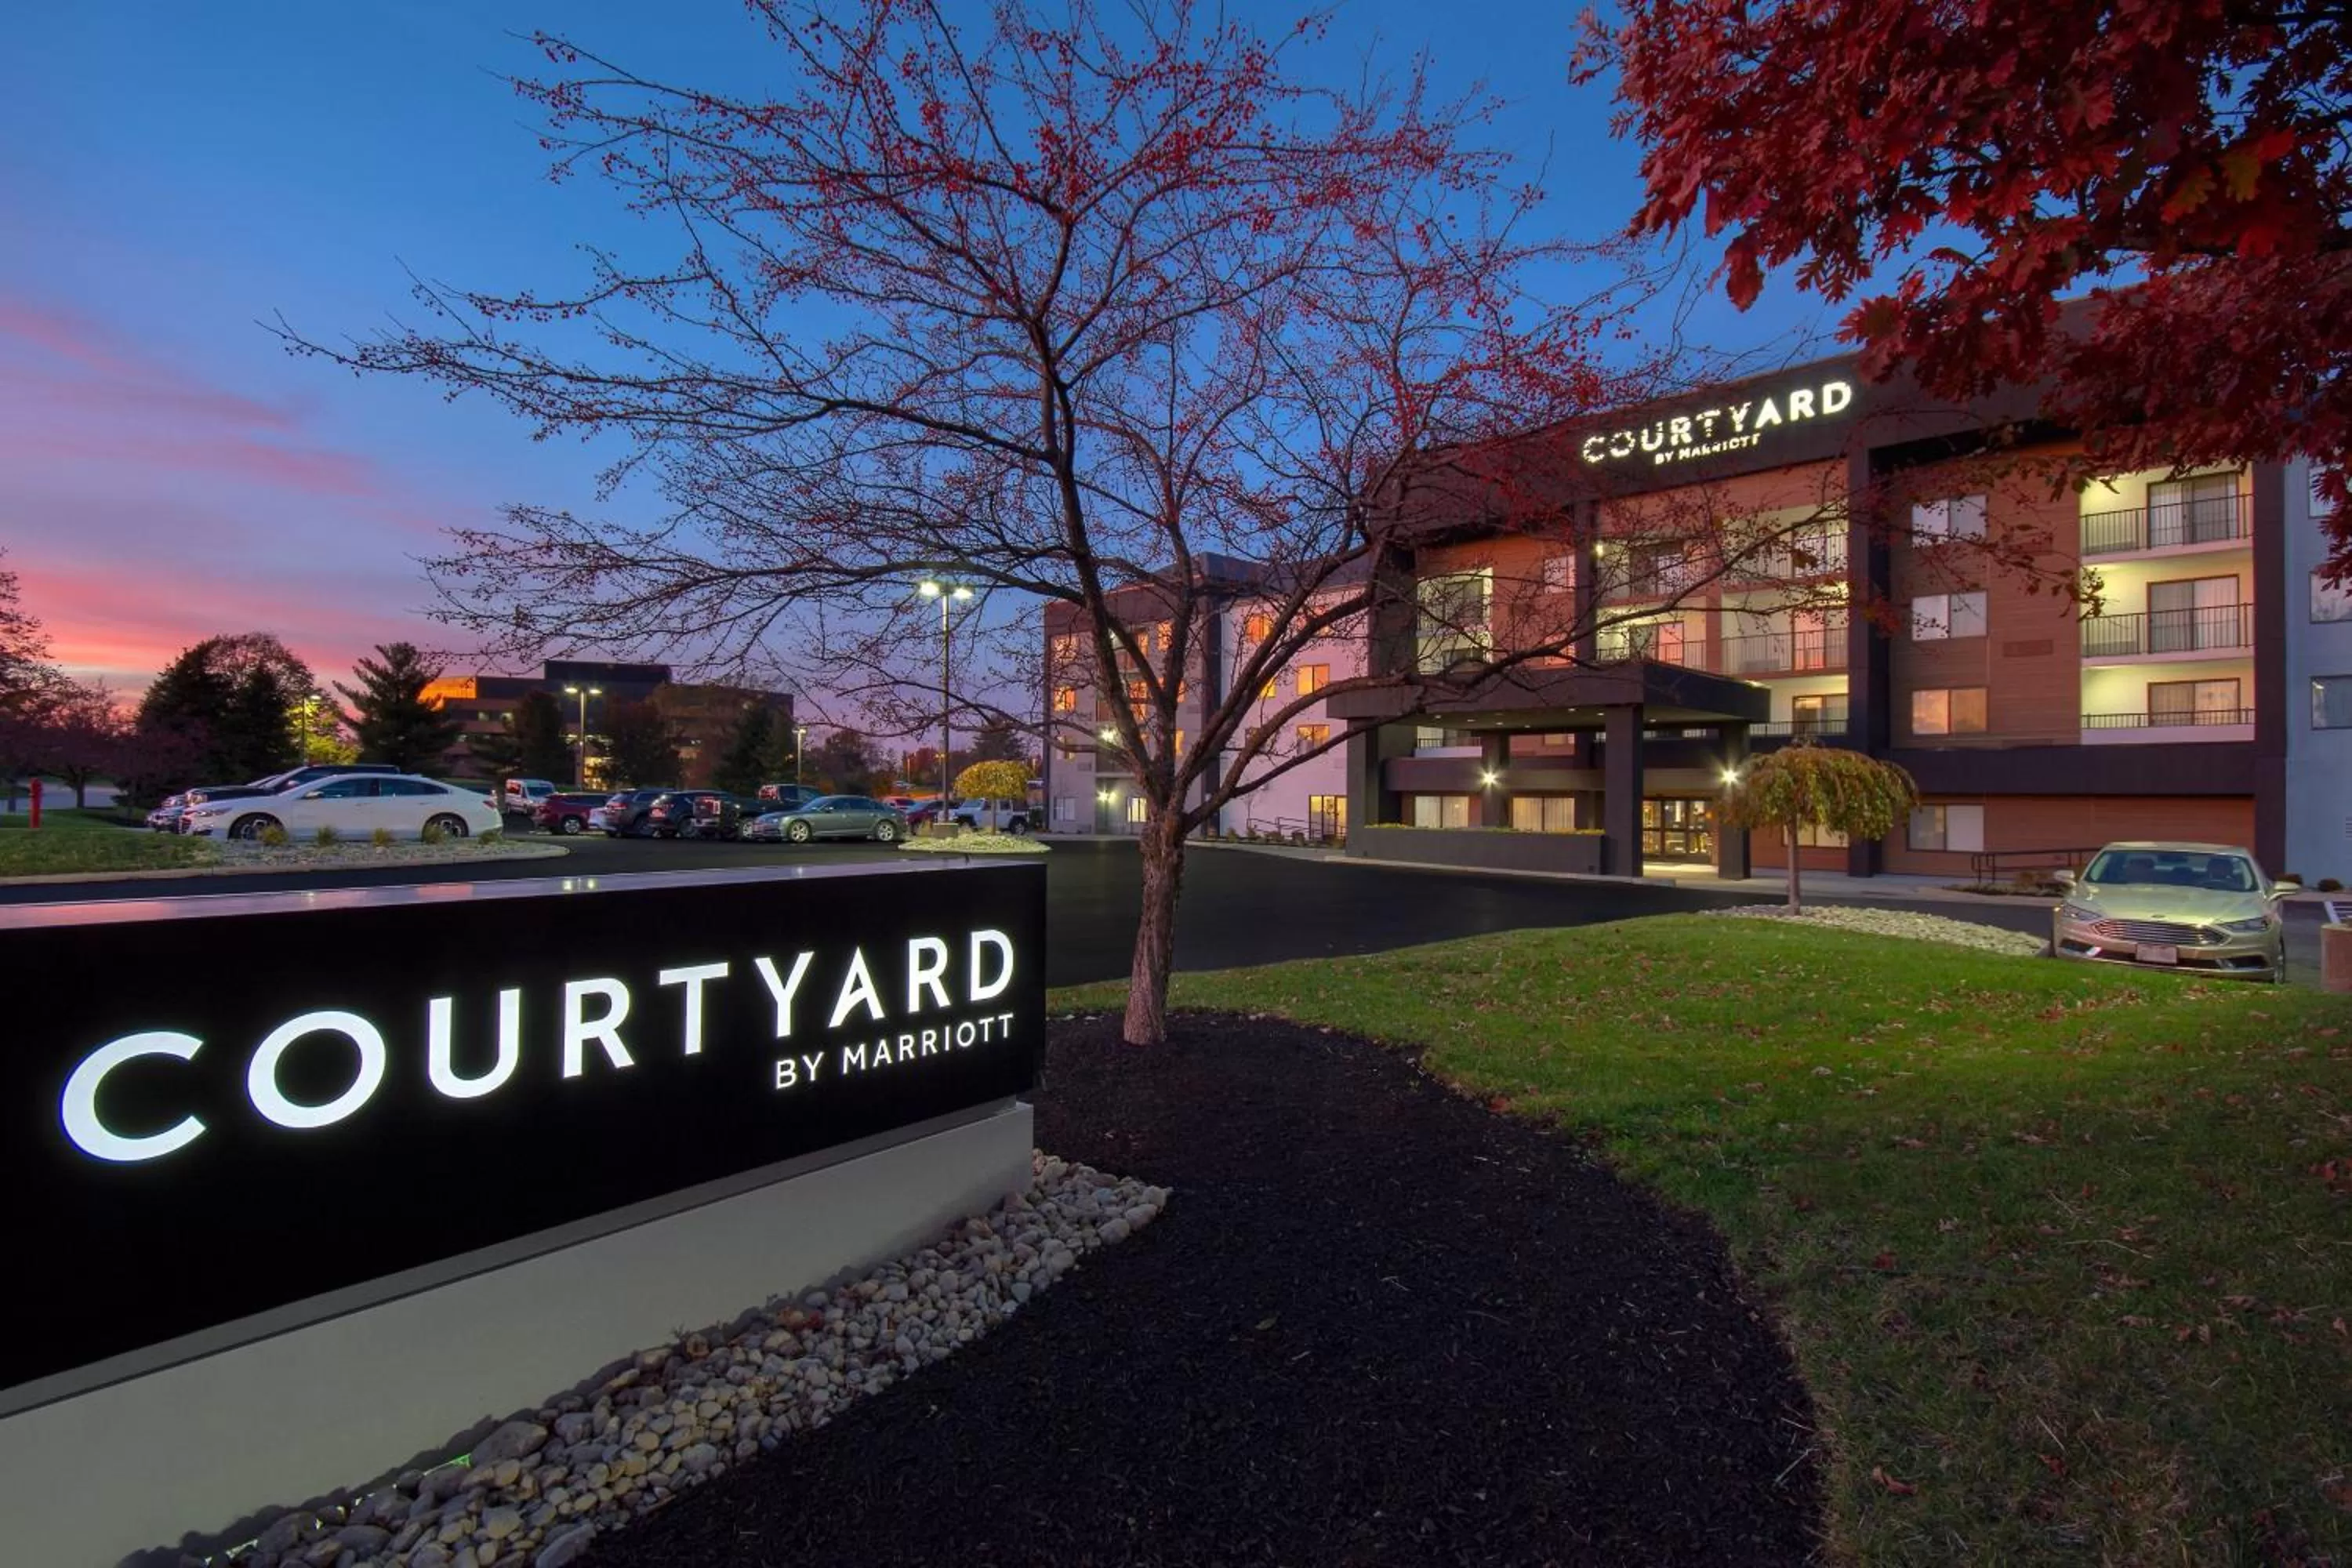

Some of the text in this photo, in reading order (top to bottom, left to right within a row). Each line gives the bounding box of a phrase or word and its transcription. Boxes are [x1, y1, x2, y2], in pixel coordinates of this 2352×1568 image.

[1582, 380, 1853, 464] COURTYARD
[1654, 451, 1674, 465] BY
[59, 929, 1014, 1163] COURTYARD
[775, 1013, 1015, 1090] BY MARRIOTT
